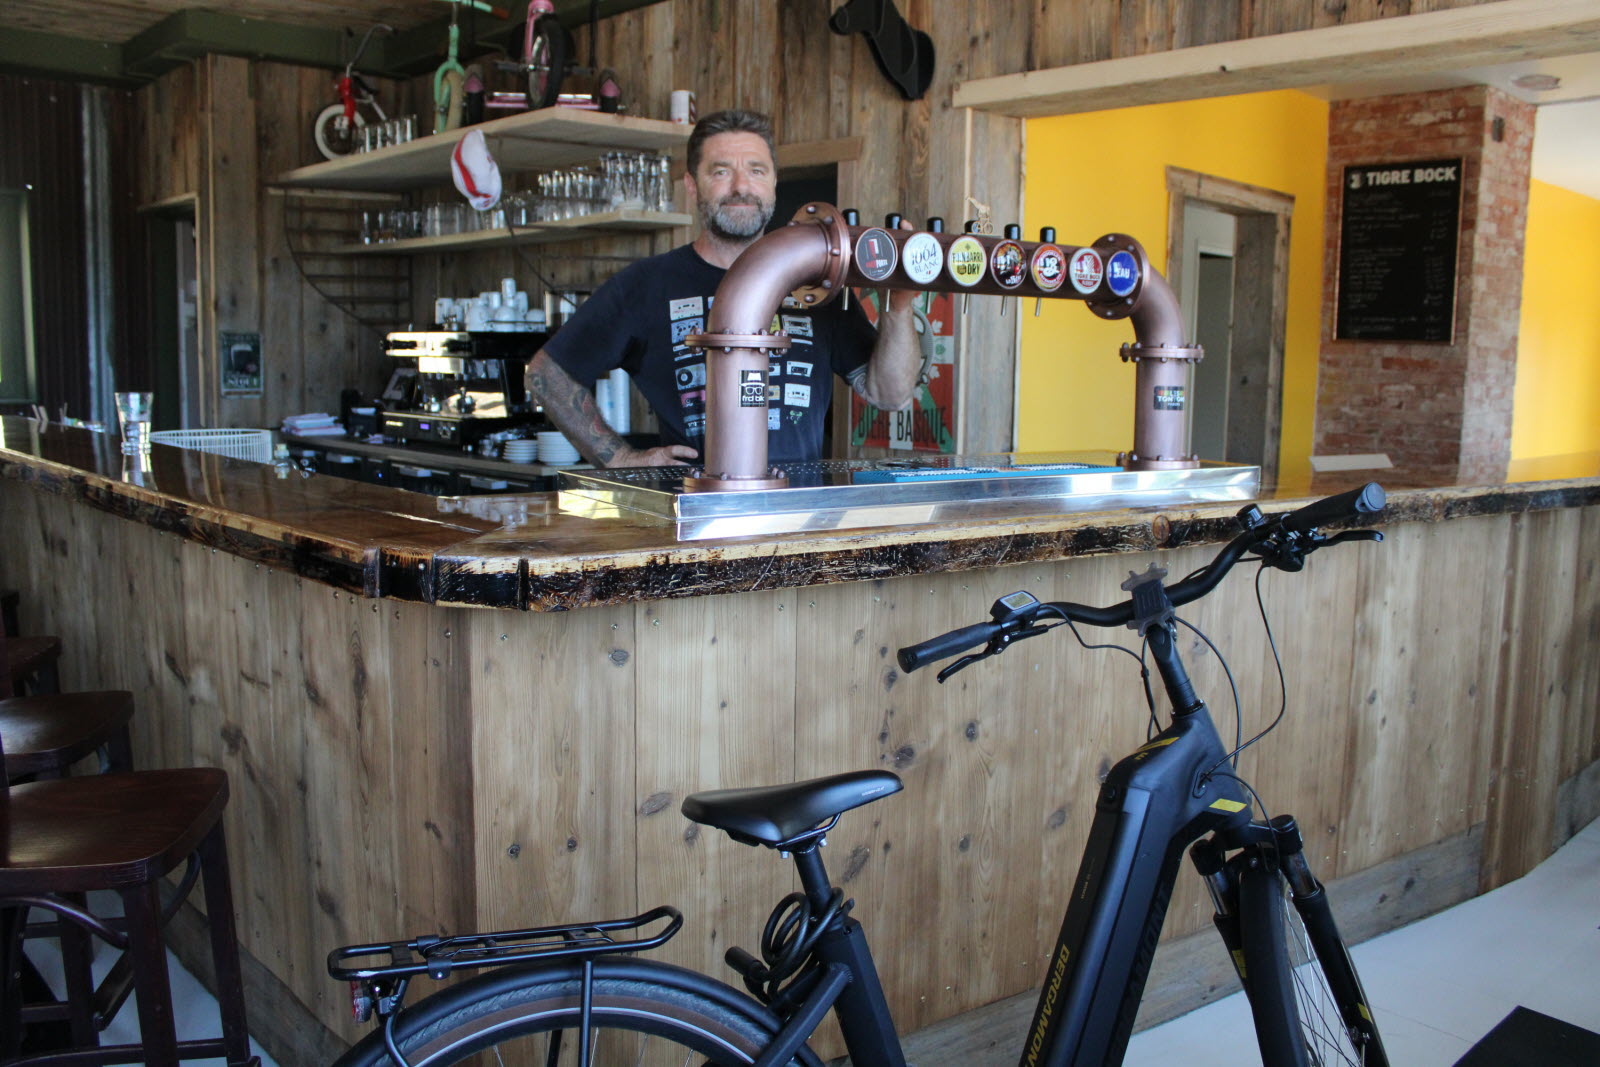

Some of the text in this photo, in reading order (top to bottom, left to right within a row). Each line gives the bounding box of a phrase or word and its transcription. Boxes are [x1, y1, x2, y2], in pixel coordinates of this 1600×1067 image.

[1366, 166, 1457, 186] TIGRE BOCK
[967, 263, 981, 275] DRY
[1025, 943, 1071, 1067] BERGAMON
